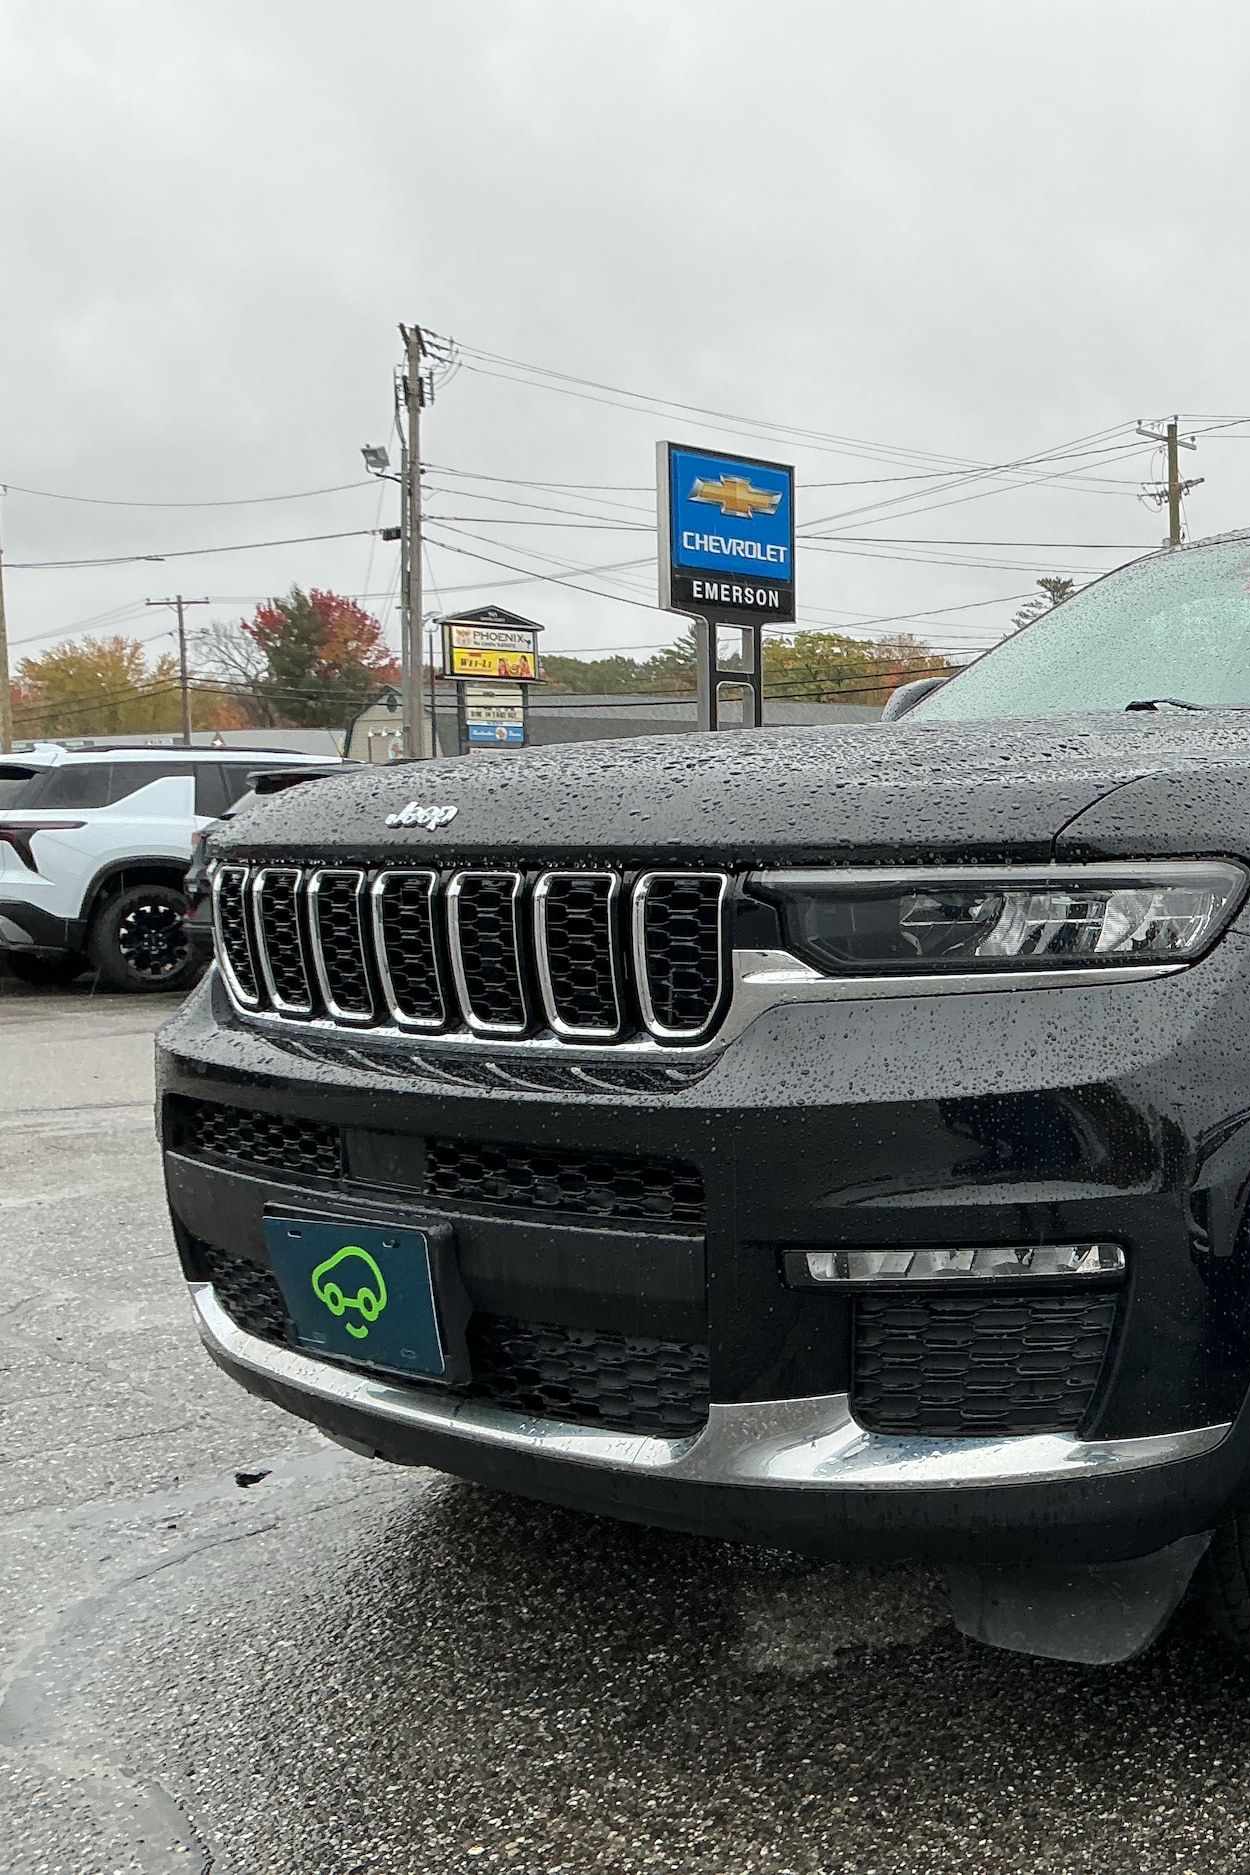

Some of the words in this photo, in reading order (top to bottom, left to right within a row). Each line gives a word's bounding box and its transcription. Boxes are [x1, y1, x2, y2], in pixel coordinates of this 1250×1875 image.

[682, 531, 788, 564] CHEVROLET
[692, 580, 780, 608] EMERSON
[473, 630, 525, 644] PHOENIX
[385, 801, 459, 832] Jeep
